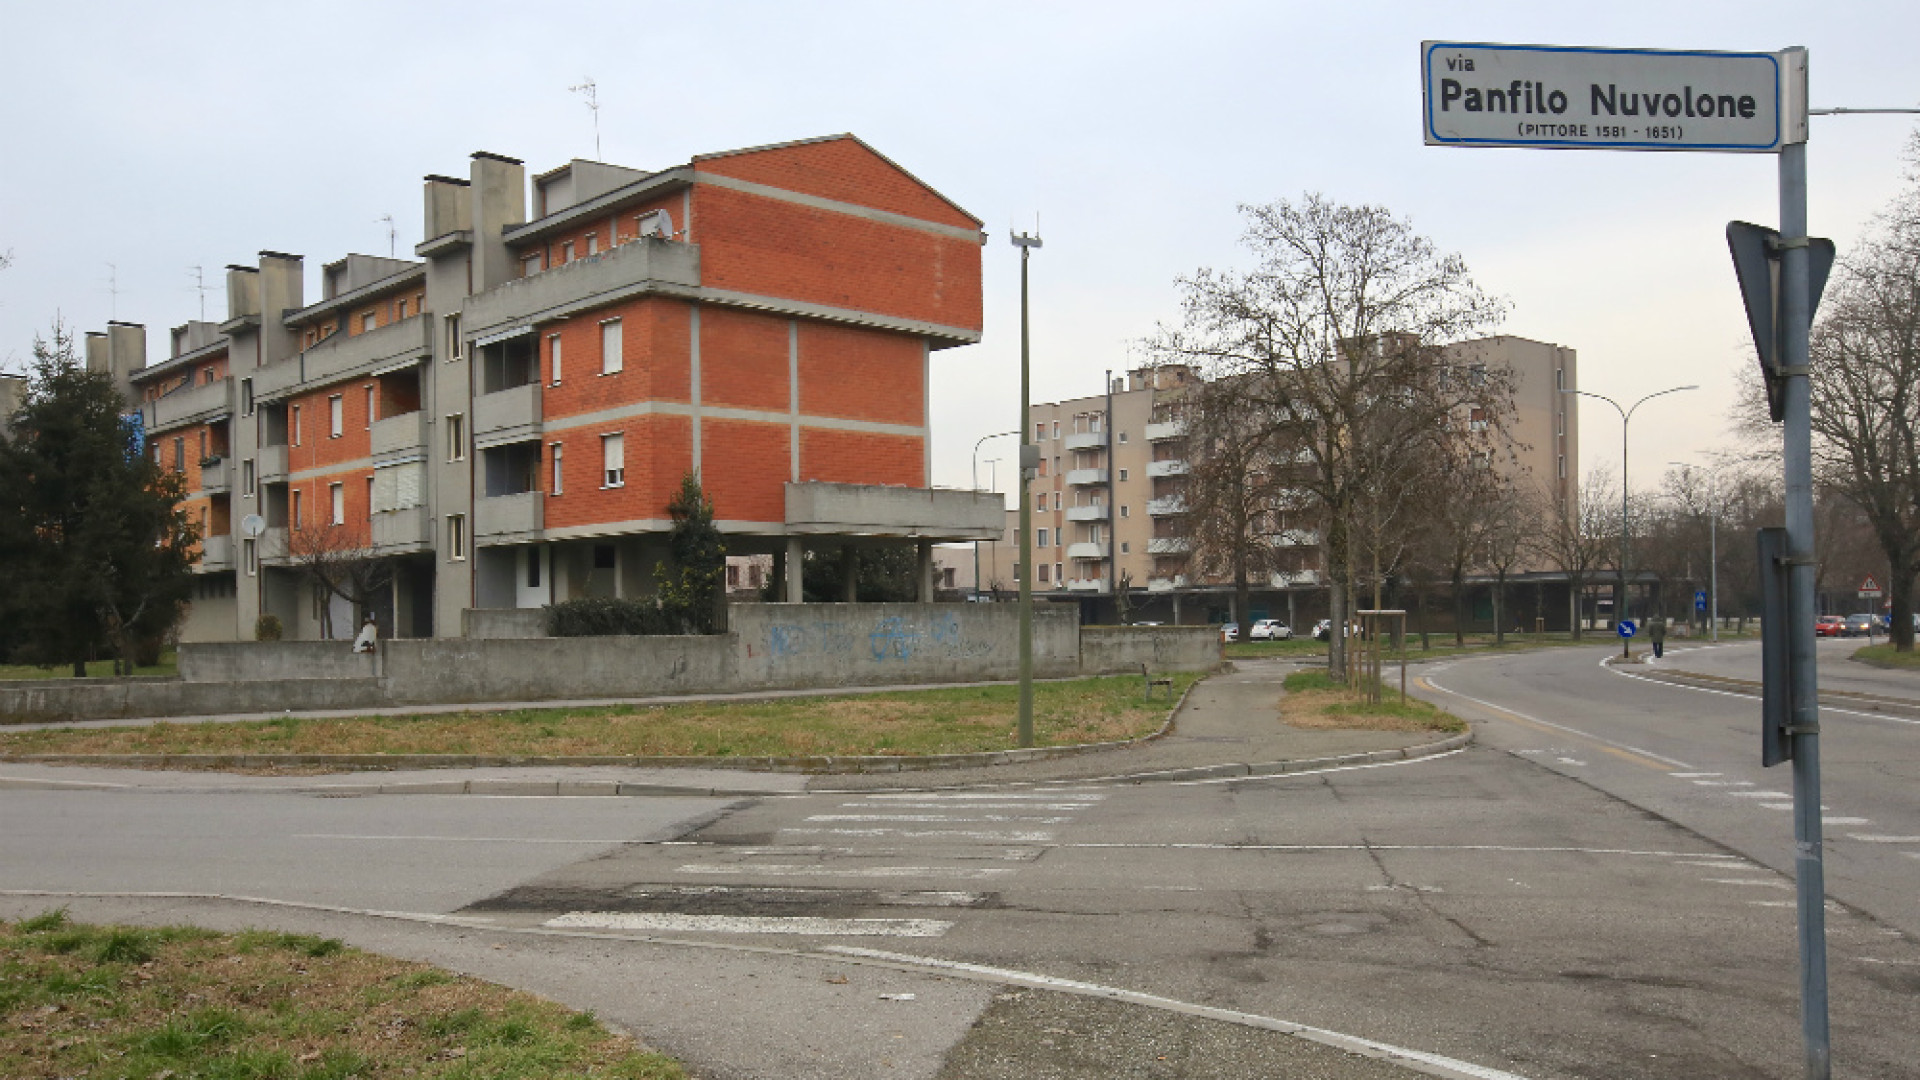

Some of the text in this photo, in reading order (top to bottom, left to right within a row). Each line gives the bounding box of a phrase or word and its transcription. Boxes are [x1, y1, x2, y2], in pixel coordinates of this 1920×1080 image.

[1446, 53, 1475, 71] via
[1441, 78, 1756, 119] Panfilo Nuvolone
[1518, 122, 1588, 137] (PITTORE
[1595, 126, 1626, 137] 1581
[1645, 126, 1683, 140] 1651)
